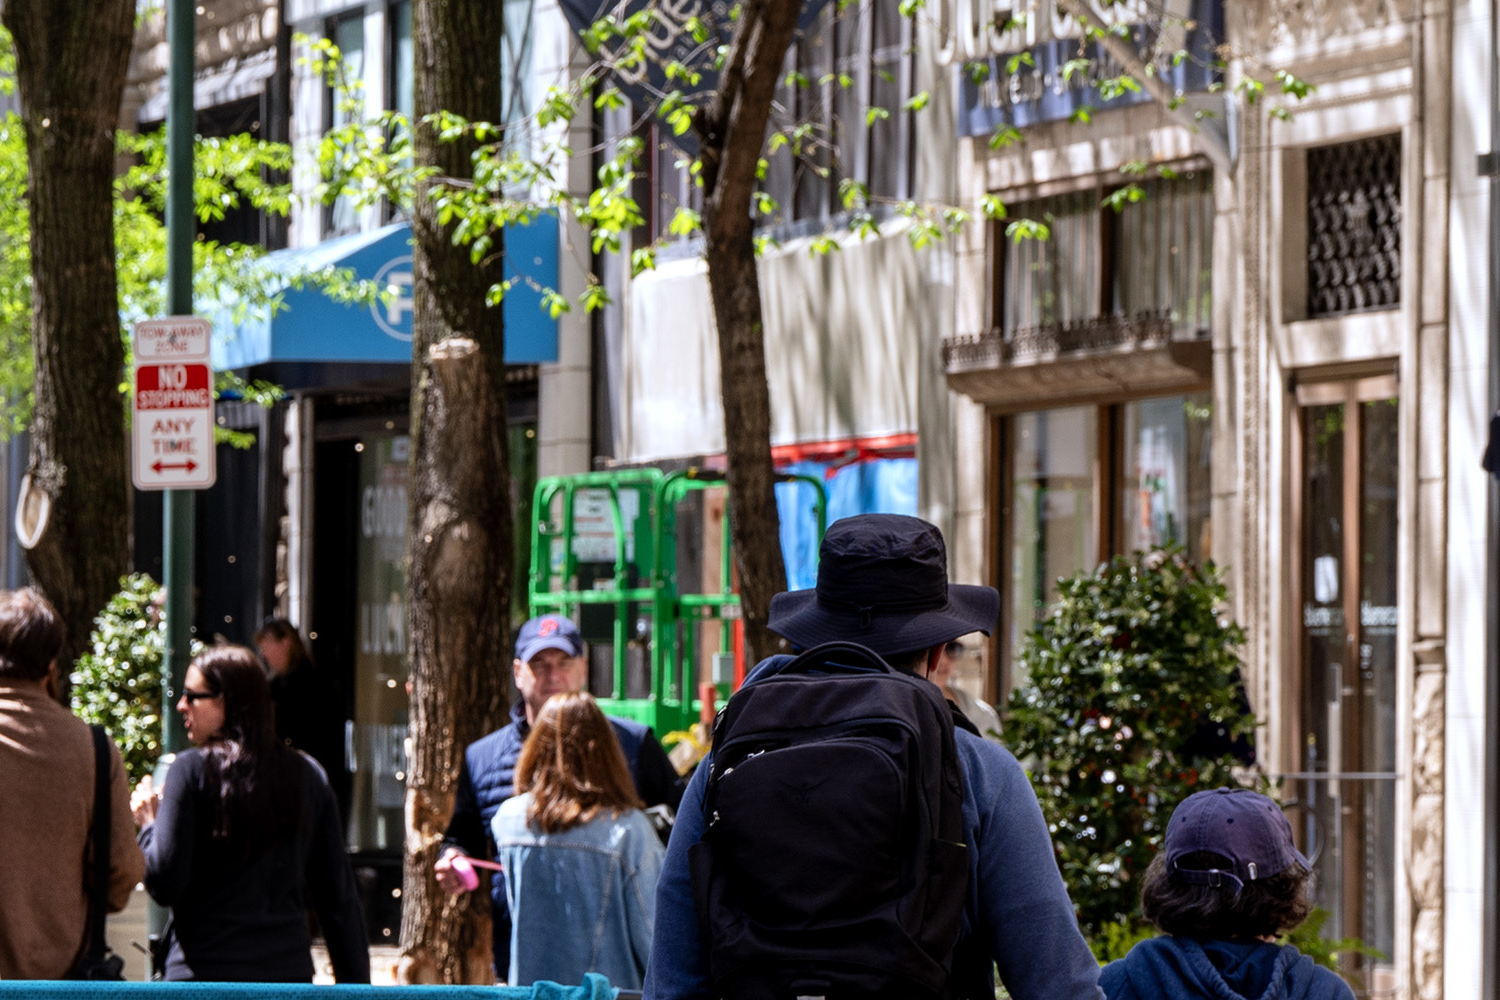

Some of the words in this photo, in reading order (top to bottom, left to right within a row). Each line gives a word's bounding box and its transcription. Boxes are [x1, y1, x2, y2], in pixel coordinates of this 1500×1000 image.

[158, 364, 188, 390] NO
[137, 388, 208, 407] STOPPING
[152, 417, 196, 435] ANY
[152, 438, 196, 455] TIME
